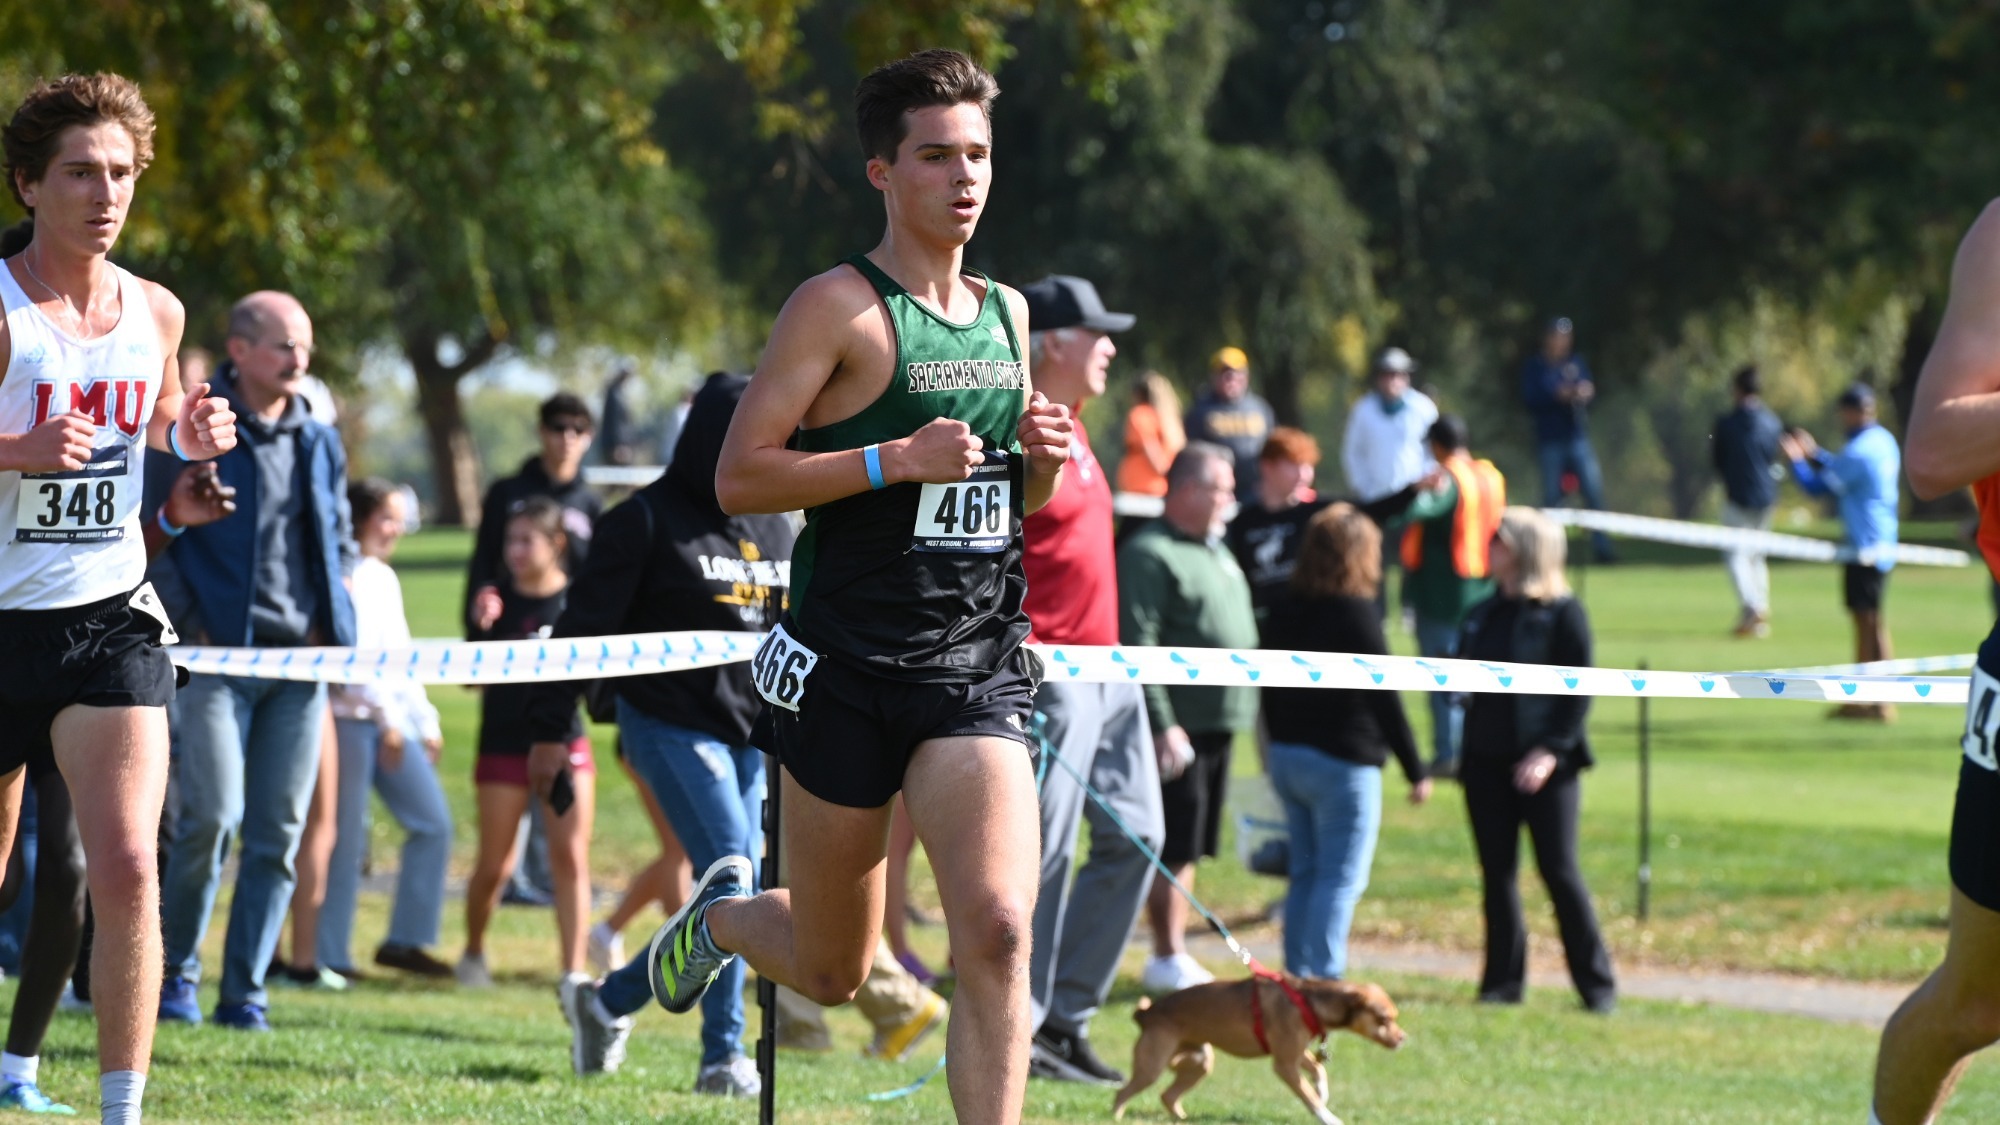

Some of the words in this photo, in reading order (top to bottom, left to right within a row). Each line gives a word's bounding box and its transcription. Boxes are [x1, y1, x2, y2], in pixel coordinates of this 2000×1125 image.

[907, 360, 997, 393] SACRAMENTO
[995, 360, 1024, 390] STATE
[37, 480, 115, 528] 348
[933, 484, 1001, 535] 466
[29, 531, 45, 539] WEST
[44, 531, 69, 539] REGIONAL
[75, 531, 102, 539] NOVEMBER
[752, 631, 808, 703] 466
